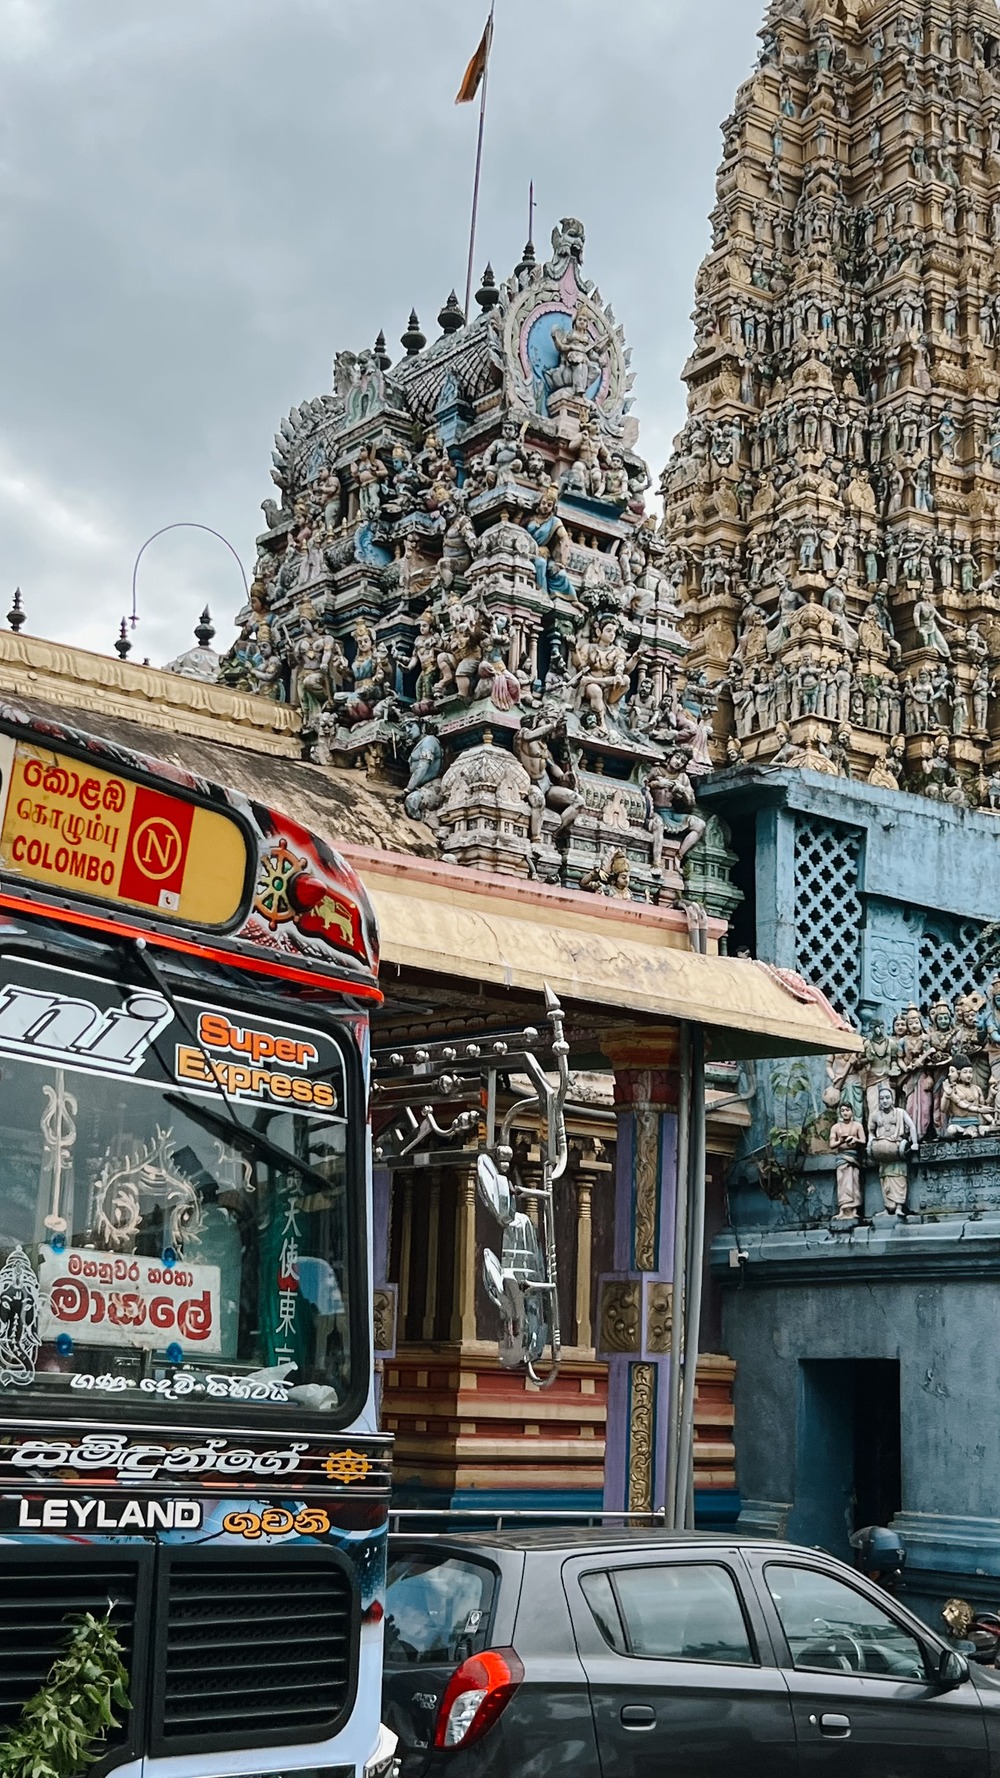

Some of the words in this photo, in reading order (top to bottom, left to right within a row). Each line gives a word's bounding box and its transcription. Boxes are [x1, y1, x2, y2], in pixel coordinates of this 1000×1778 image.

[23, 759, 126, 813] කොළඹ
[17, 798, 119, 853] கொழும்பு
[142, 828, 175, 868] N
[12, 835, 115, 885] COLOMBO
[199, 1013, 316, 1066] Super
[177, 1045, 335, 1107] Express
[18, 1500, 201, 1529] LEYLAND
